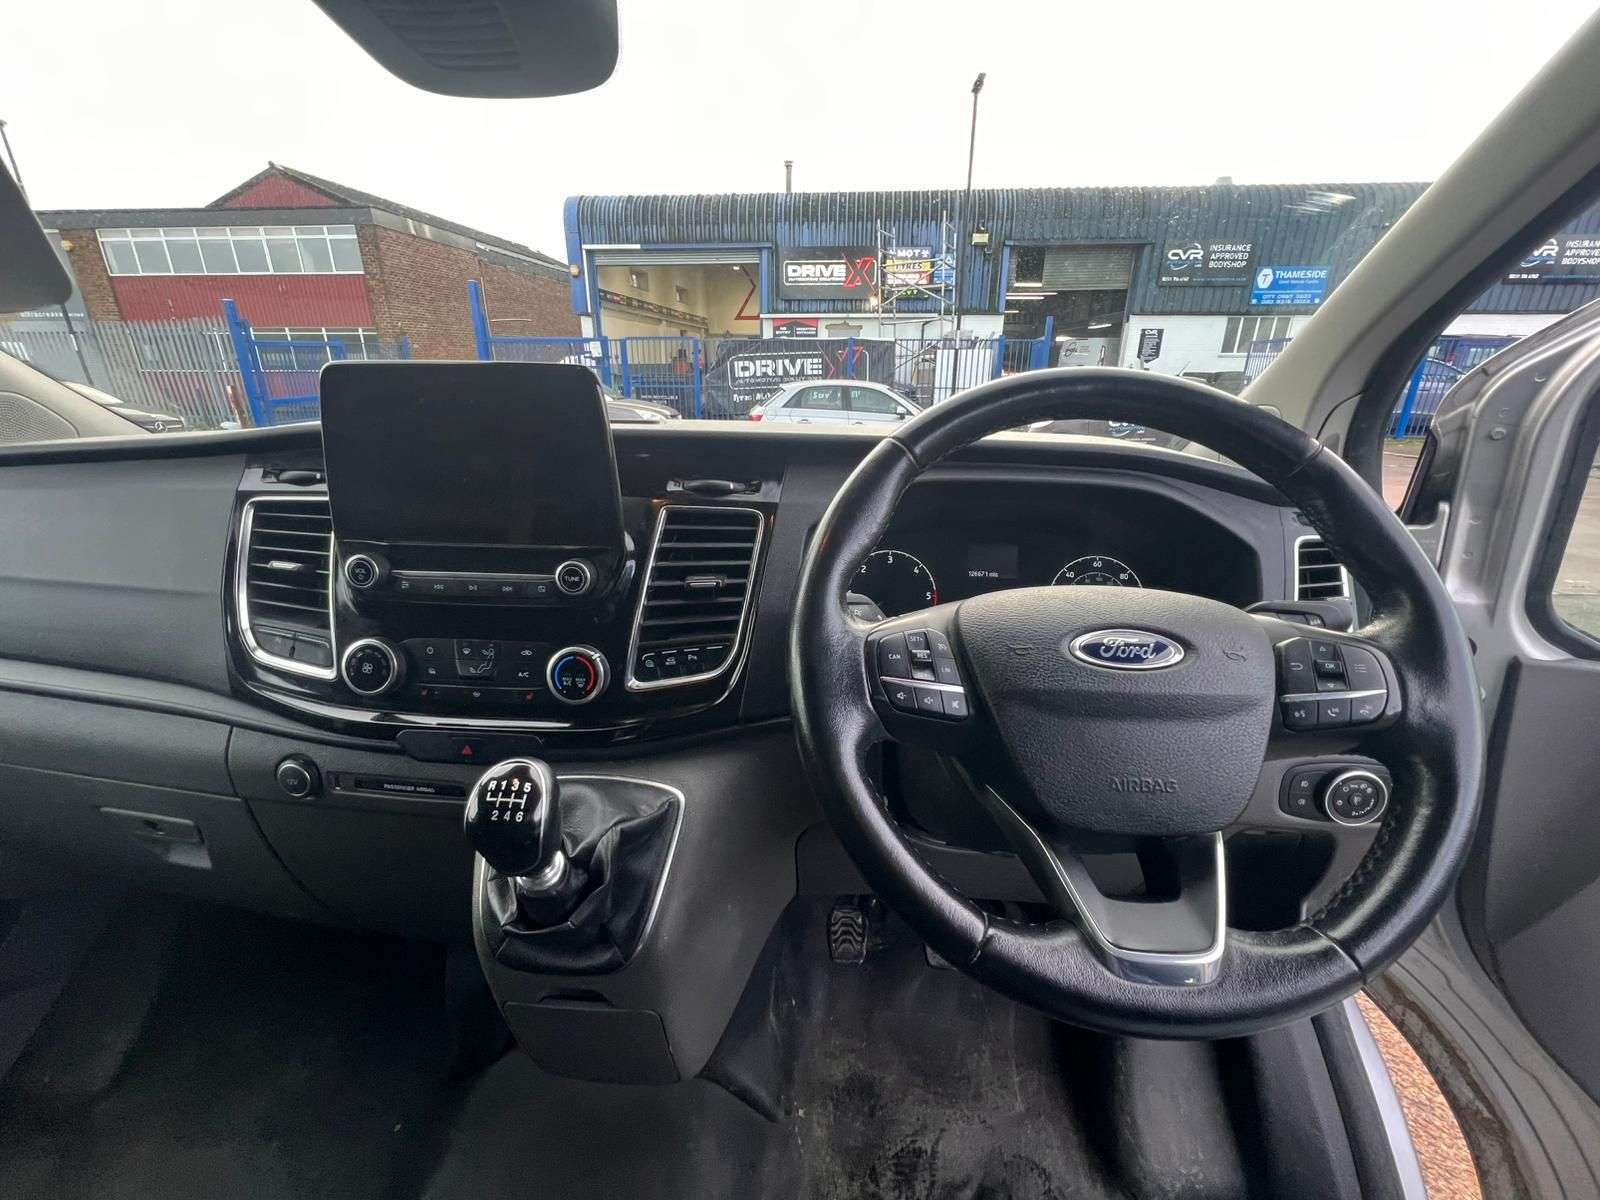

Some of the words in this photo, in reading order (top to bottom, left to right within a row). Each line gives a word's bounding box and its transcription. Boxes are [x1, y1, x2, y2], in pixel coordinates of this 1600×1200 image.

[1210, 244, 1252, 252] INSURANCE
[1210, 252, 1249, 260] APPROVED
[787, 264, 847, 277] DRIVE
[1275, 270, 1328, 279] THAMESIDE
[734, 358, 822, 377] DRIVE
[887, 555, 893, 564] 3
[1092, 560, 1103, 568] 60
[861, 565, 867, 573] 2
[914, 566, 920, 574] 4
[926, 592, 932, 600] 5
[1100, 637, 1157, 659] Ford
[488, 780, 497, 790] R
[501, 779, 507, 790] 1
[511, 778, 520, 791] 3
[523, 782, 532, 793] 5
[1110, 775, 1179, 793] AIRBAG
[491, 809, 499, 821] 2
[503, 810, 511, 822] 4
[515, 811, 524, 823] 6
